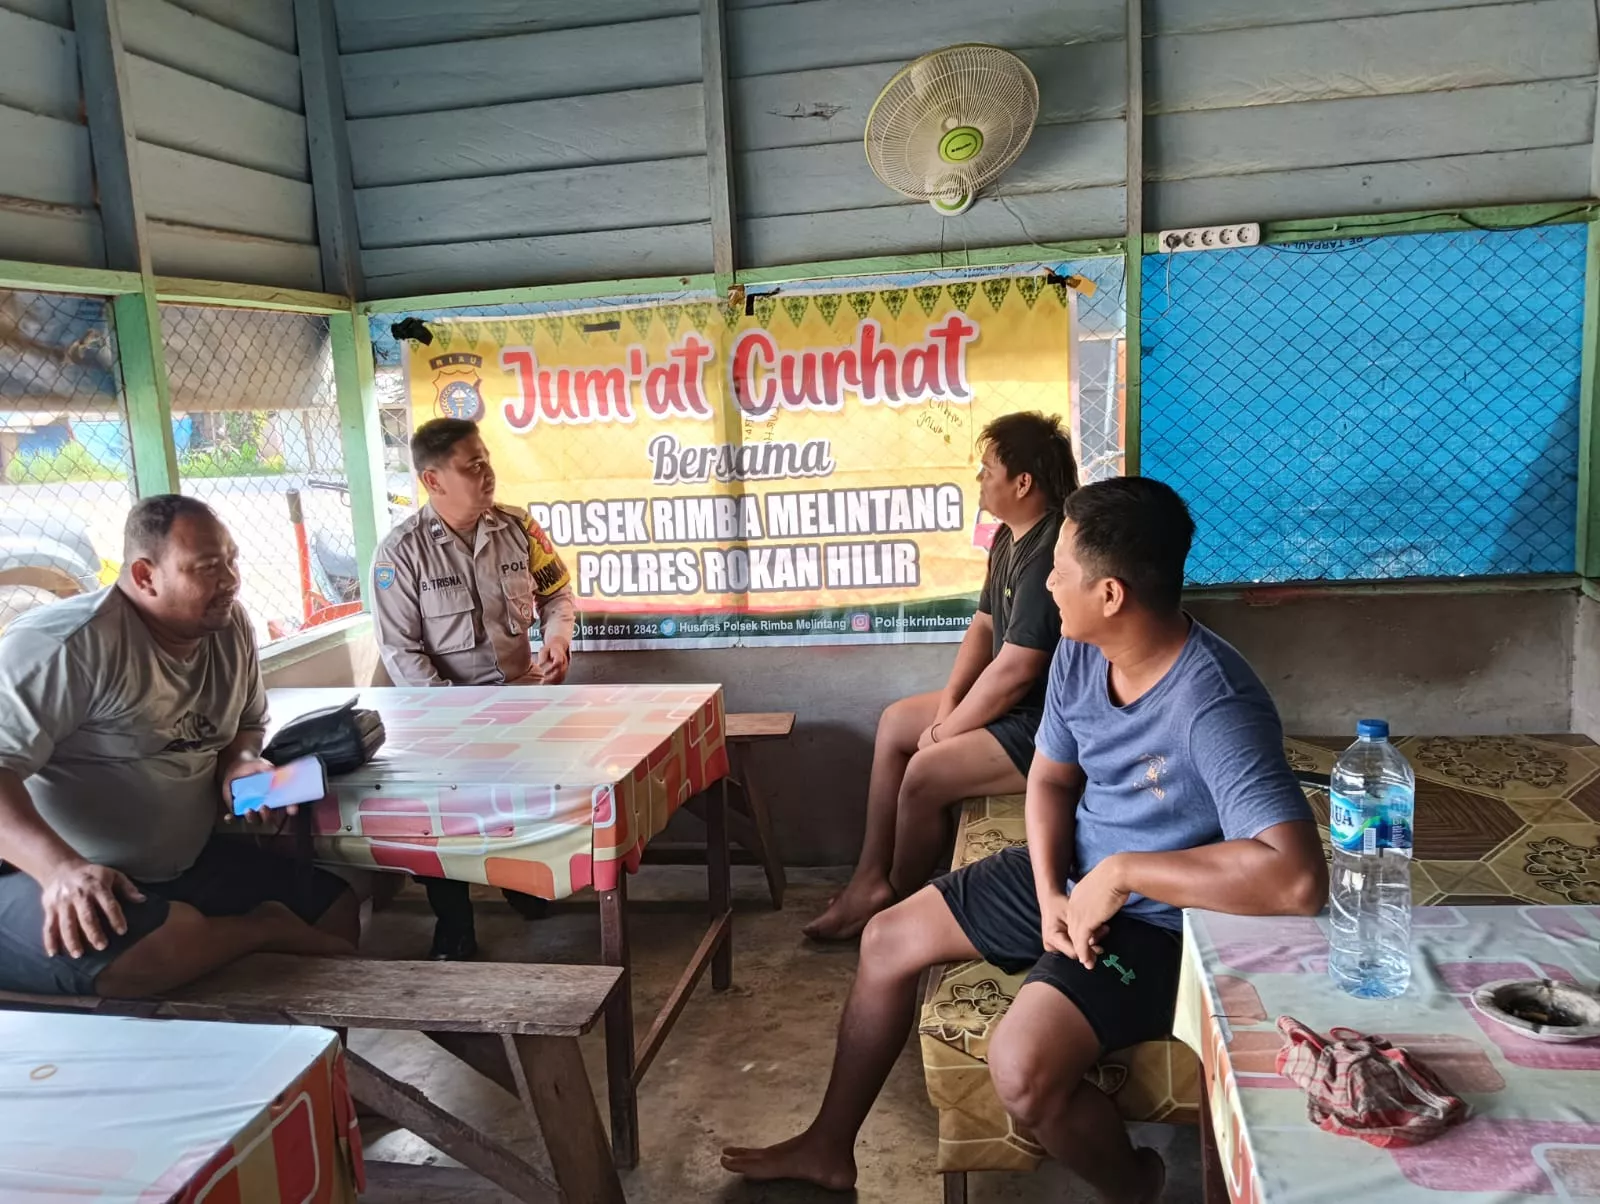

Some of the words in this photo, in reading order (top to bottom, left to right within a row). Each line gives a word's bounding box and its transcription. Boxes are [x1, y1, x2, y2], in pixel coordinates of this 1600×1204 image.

[434, 354, 479, 367] RIAU
[501, 333, 713, 431] Jum'at
[730, 314, 976, 418] Curhat
[650, 435, 832, 482] Bersama
[529, 500, 650, 546] POLSEK
[652, 494, 764, 542] RIMBA
[767, 483, 962, 538] MELINTANG
[430, 575, 462, 590] TRISNA
[578, 551, 702, 596] POLRES
[703, 544, 822, 594] ROKAN
[824, 540, 919, 588] HILIR
[581, 625, 605, 636] 0812
[608, 625, 630, 635] 6871
[634, 624, 657, 635] 2842
[679, 621, 721, 632] Husmas
[724, 620, 758, 631] Polsek
[760, 619, 794, 631] Rimba
[796, 619, 847, 631] Melintang
